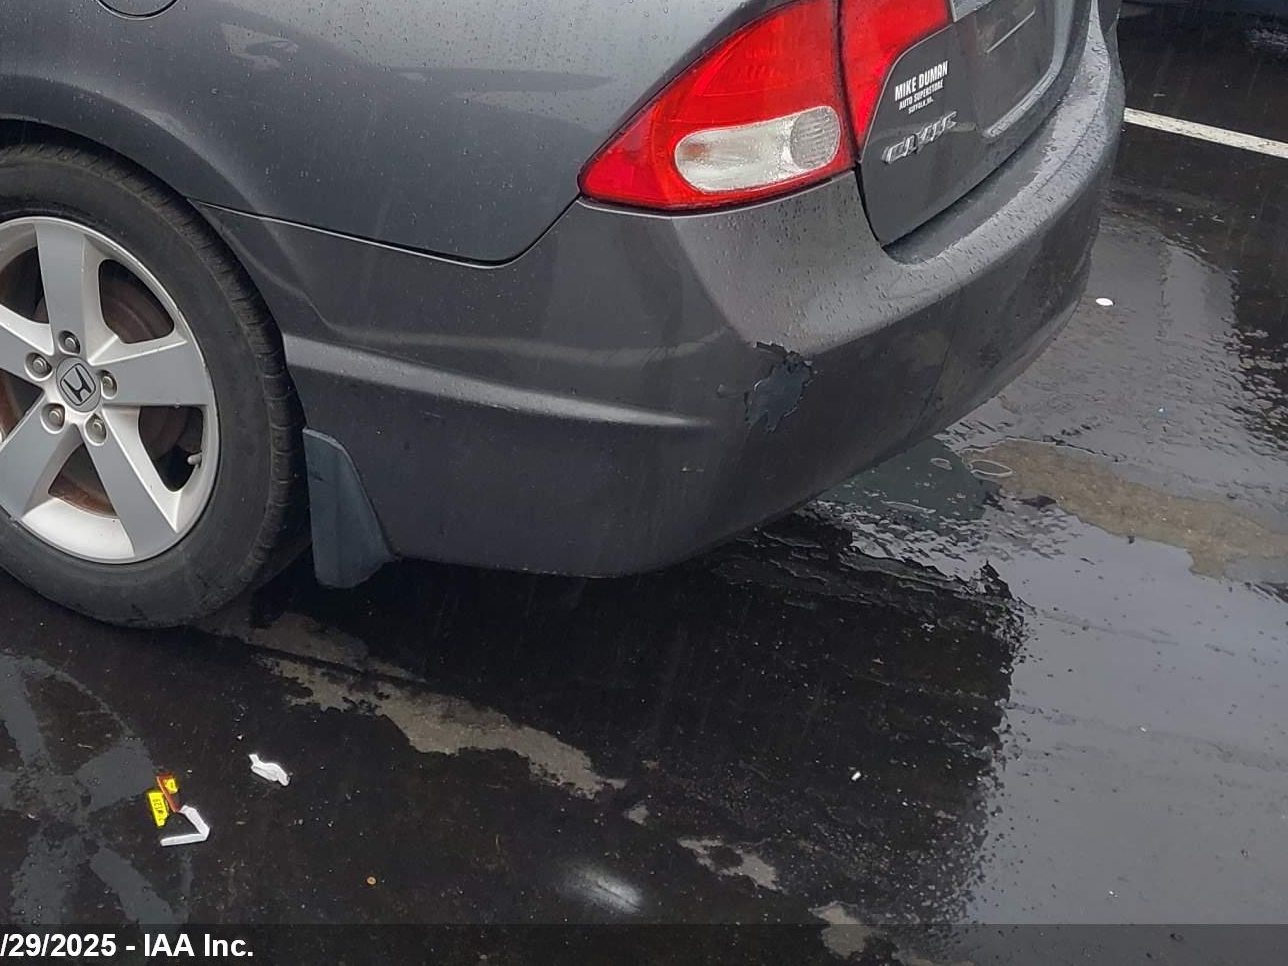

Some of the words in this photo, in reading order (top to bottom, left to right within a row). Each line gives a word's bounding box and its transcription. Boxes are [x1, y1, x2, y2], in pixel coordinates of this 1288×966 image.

[895, 76, 917, 101] MIKE
[918, 60, 948, 89] DUMAN
[899, 95, 913, 110] AUTO
[913, 78, 943, 103] SUPERSTORE
